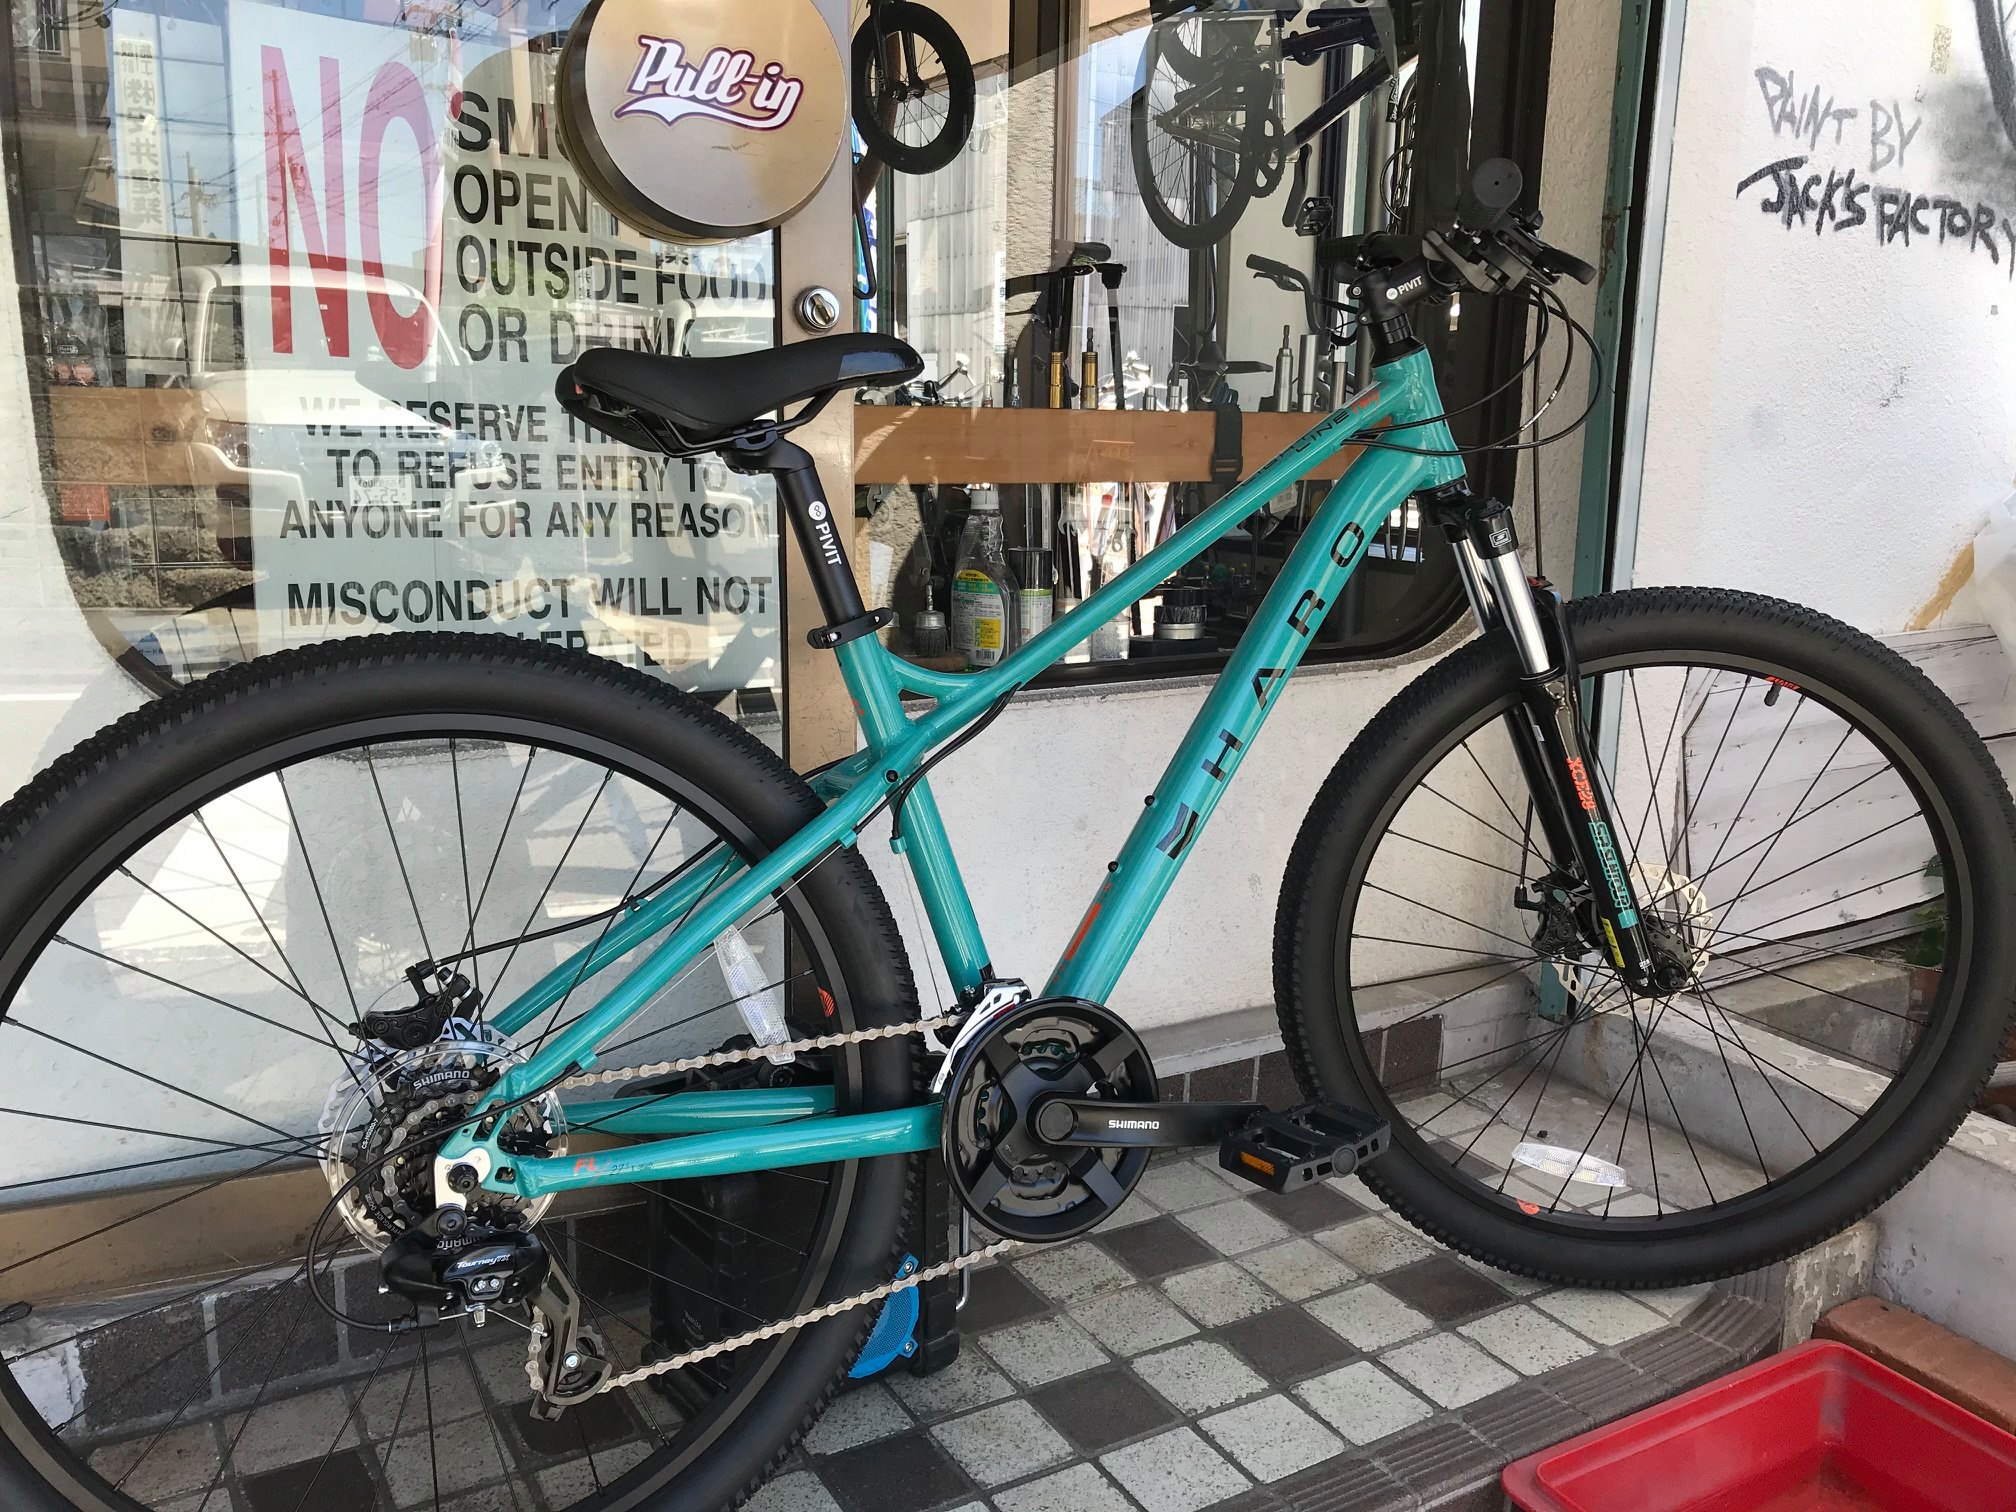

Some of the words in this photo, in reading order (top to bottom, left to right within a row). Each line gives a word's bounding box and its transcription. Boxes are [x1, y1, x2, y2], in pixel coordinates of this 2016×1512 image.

[626, 34, 804, 120] Pull-in
[1754, 66, 1858, 151] PAINT
[1870, 99, 1922, 173] BY
[261, 44, 444, 370] NO
[453, 164, 588, 234] OPEN
[456, 234, 639, 304] OUTSIDE
[656, 252, 767, 309] FOOD
[1396, 275, 1422, 295] PIVIT
[458, 303, 529, 363] OR
[299, 396, 363, 438] WE
[380, 399, 549, 444] RESERVE
[327, 449, 382, 489] TO
[398, 450, 542, 492] REFUSE
[557, 454, 670, 495] ENTRY
[682, 455, 728, 494] TO
[280, 500, 444, 540] ANYONE
[459, 500, 532, 539] FOR
[546, 501, 618, 539] ANY
[632, 501, 770, 539] REASON
[815, 521, 842, 565] PIVIT
[288, 579, 580, 627] MISCONDUCT
[589, 576, 683, 617] WILL
[697, 576, 773, 615] NOT
[1201, 521, 1365, 782] HARO
[413, 1069, 471, 1090] SHIMANO
[1108, 1119, 1160, 1130] SHIMANO
